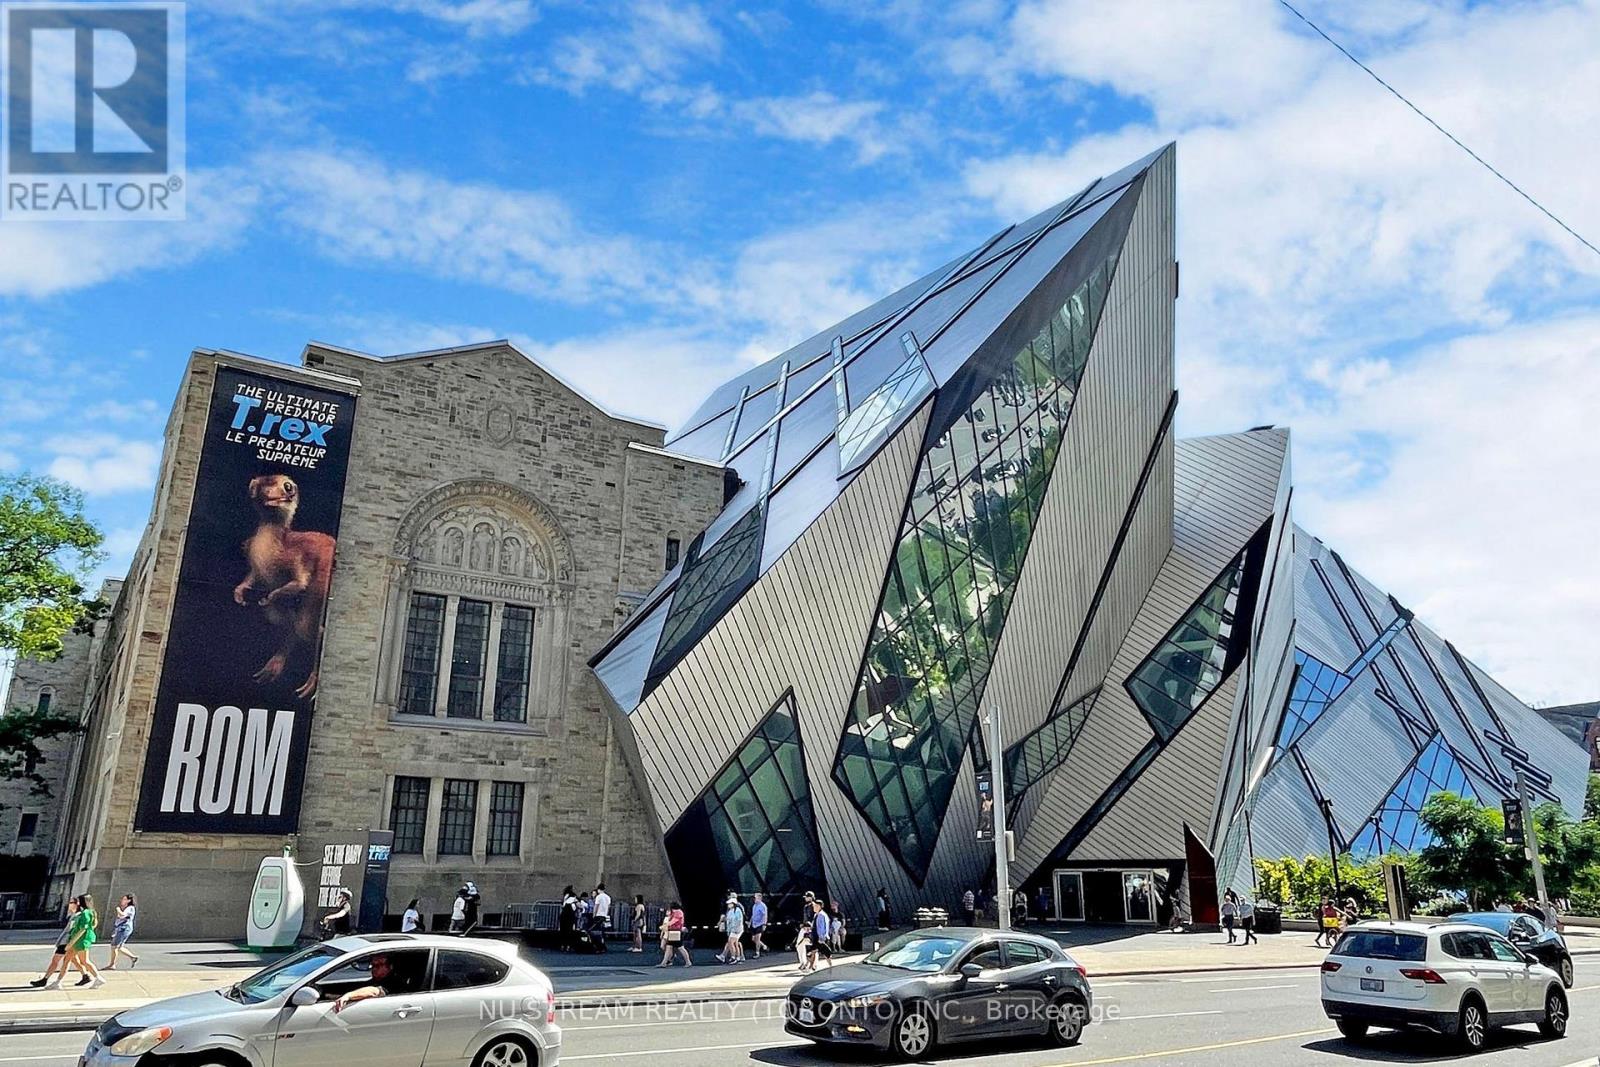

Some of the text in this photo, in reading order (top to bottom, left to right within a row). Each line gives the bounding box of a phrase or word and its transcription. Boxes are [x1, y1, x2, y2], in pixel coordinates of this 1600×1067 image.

[237, 383, 339, 415] THE ULTIMATE
[264, 401, 336, 424] PREDATOR
[230, 394, 334, 447] T.rex
[225, 430, 327, 459] LE PRÉDATEUR
[160, 702, 296, 816] ROM
[322, 844, 363, 865] SEE THE BABY
